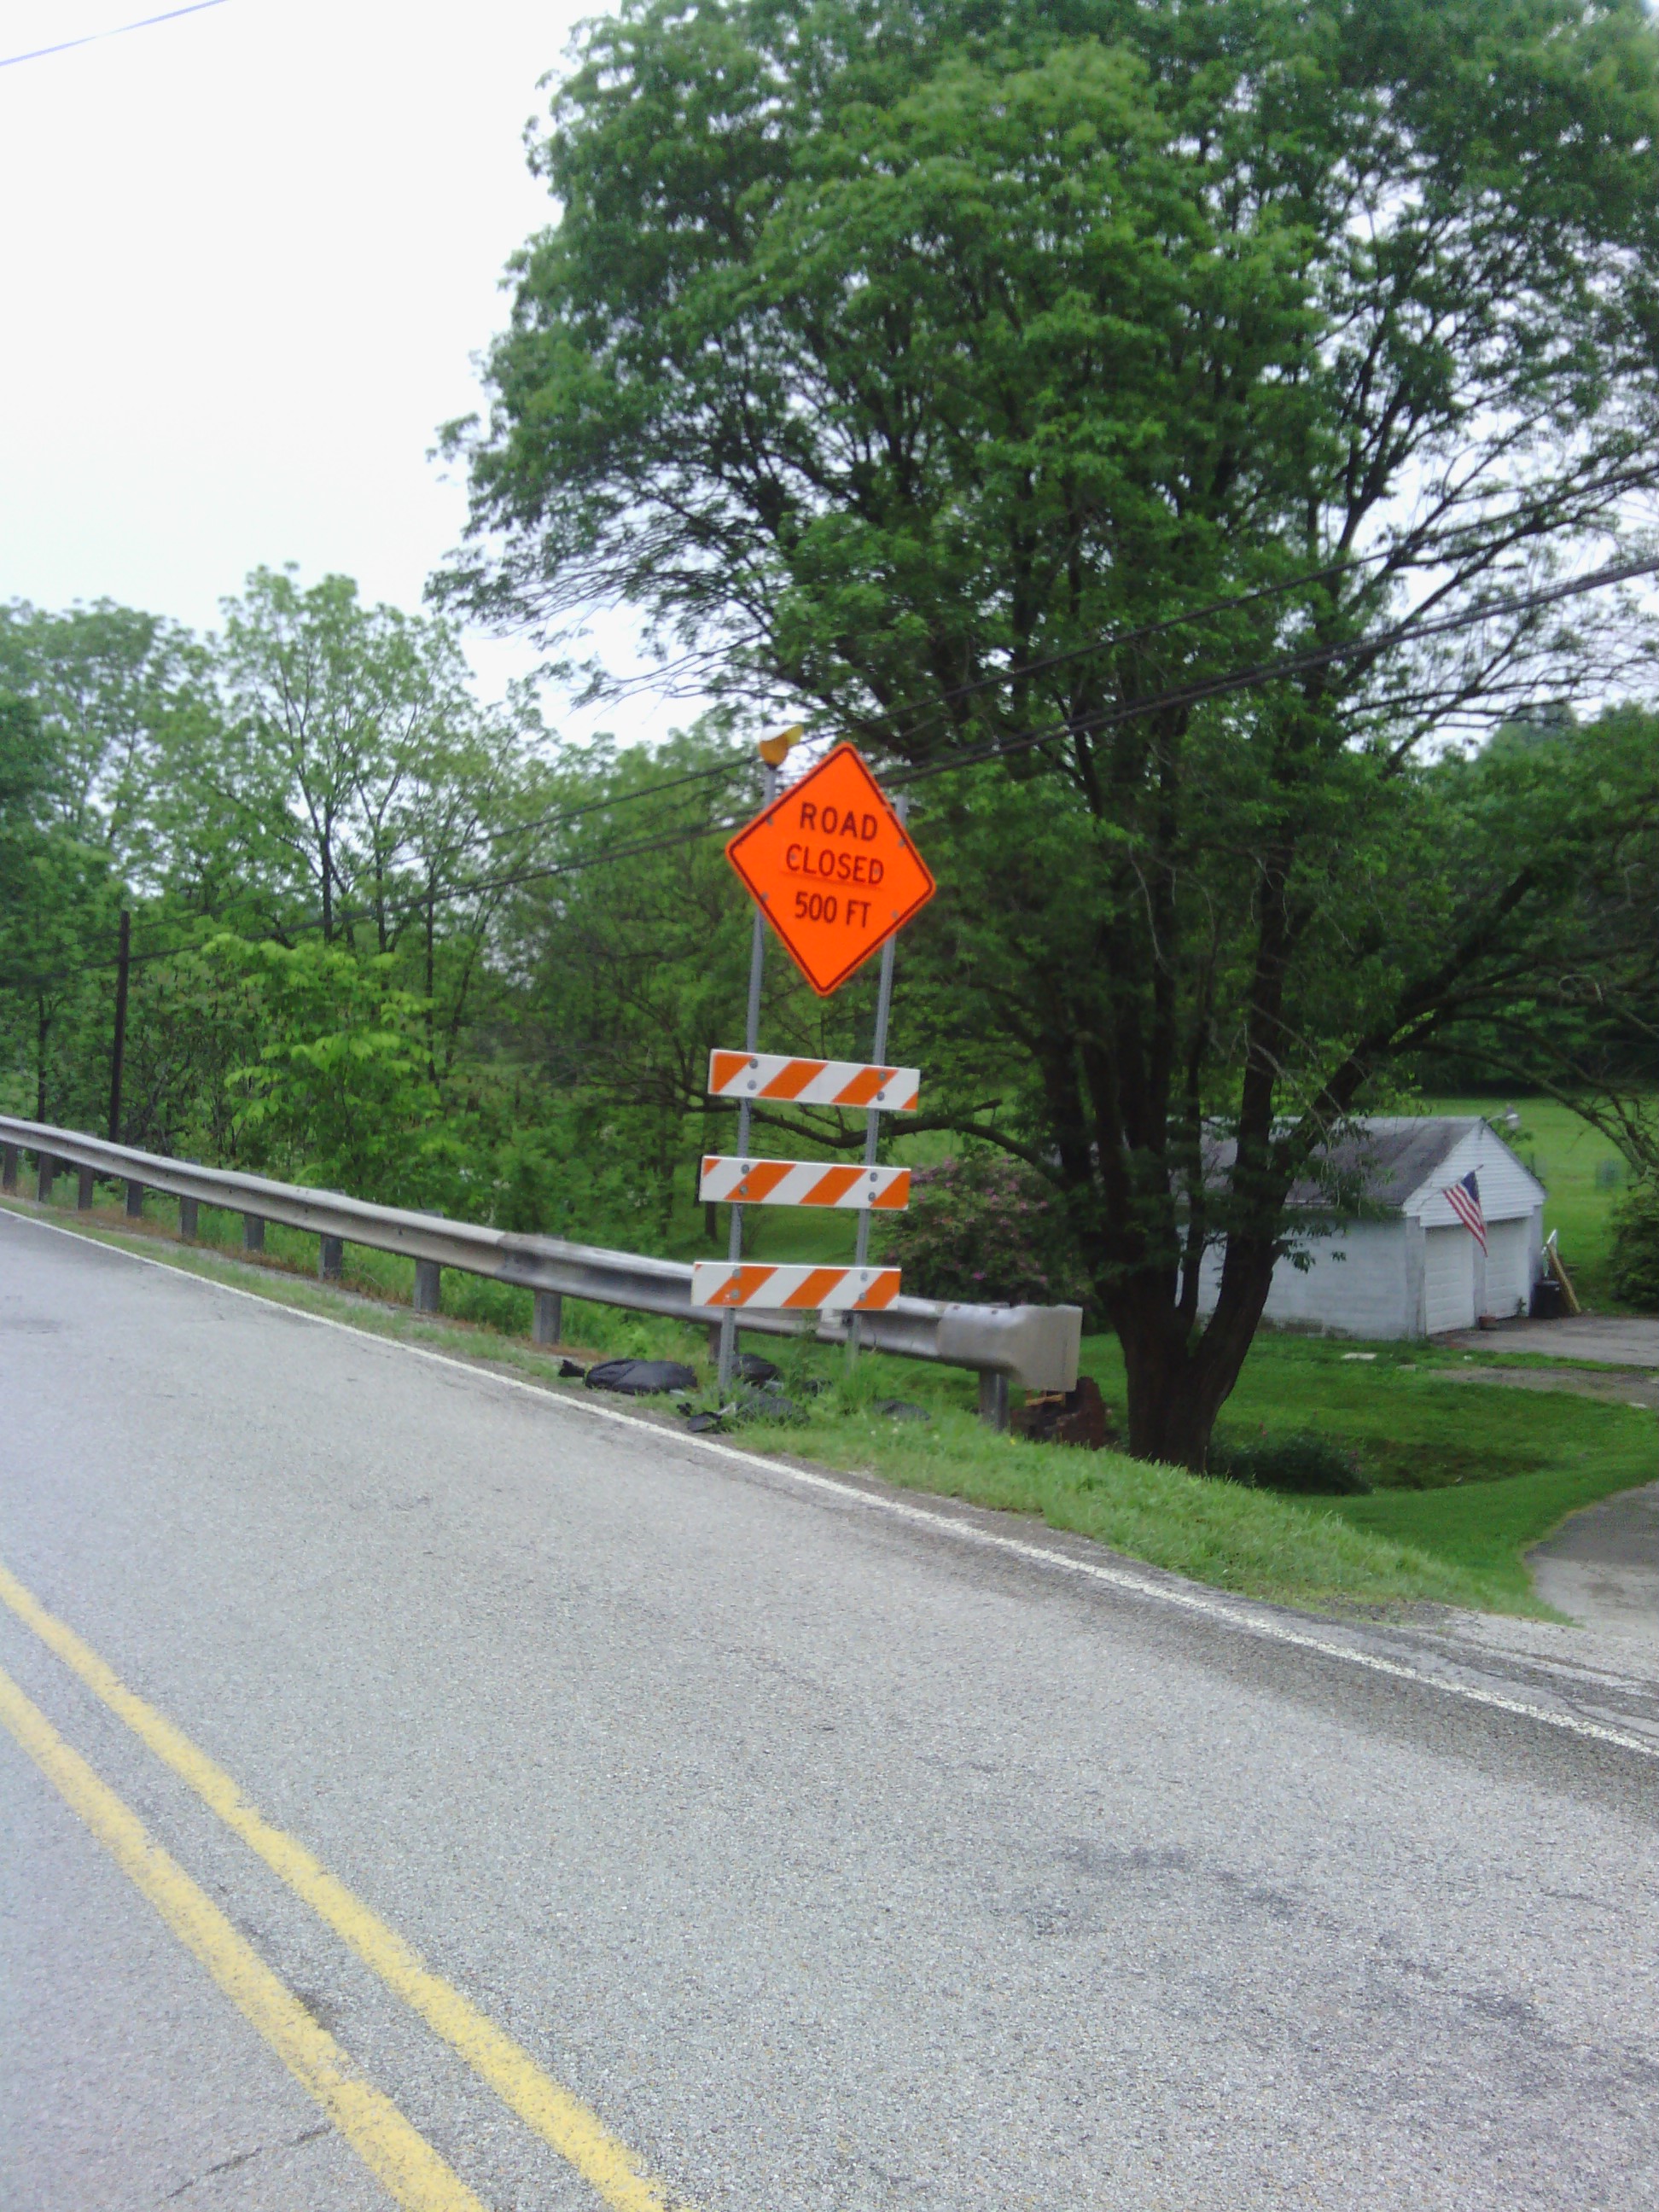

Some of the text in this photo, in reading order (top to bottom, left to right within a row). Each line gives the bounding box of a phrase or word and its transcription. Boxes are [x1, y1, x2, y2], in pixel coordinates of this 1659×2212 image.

[800, 801, 878, 841] ROAD
[786, 843, 884, 885] CLOSED
[795, 891, 871, 928] 500 FT
